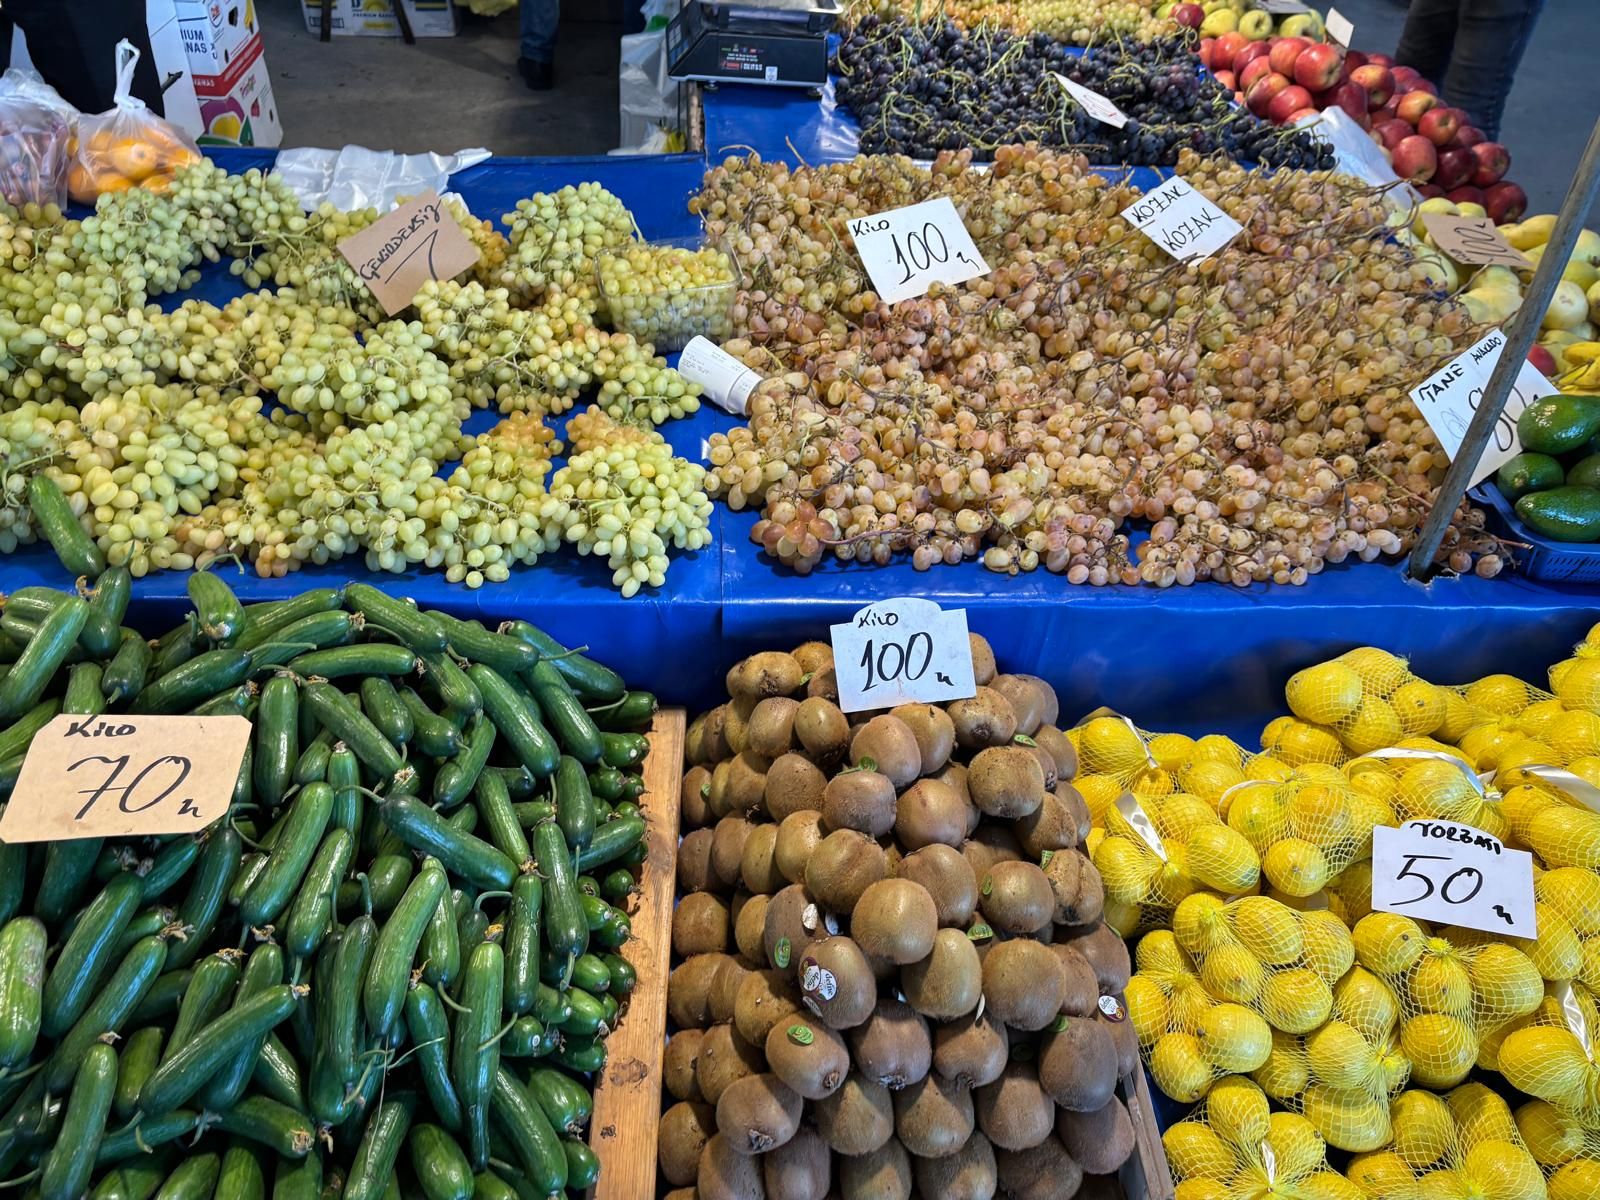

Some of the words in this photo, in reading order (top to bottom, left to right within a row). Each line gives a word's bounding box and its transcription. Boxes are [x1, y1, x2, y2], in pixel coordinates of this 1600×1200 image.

[185, 42, 208, 54] NAS
[1131, 185, 1191, 223] KOZAK
[1162, 207, 1223, 252] KOZAK
[891, 222, 948, 285] 100
[860, 632, 933, 692] 100
[66, 755, 192, 820] 70
[1389, 854, 1484, 906] 50
